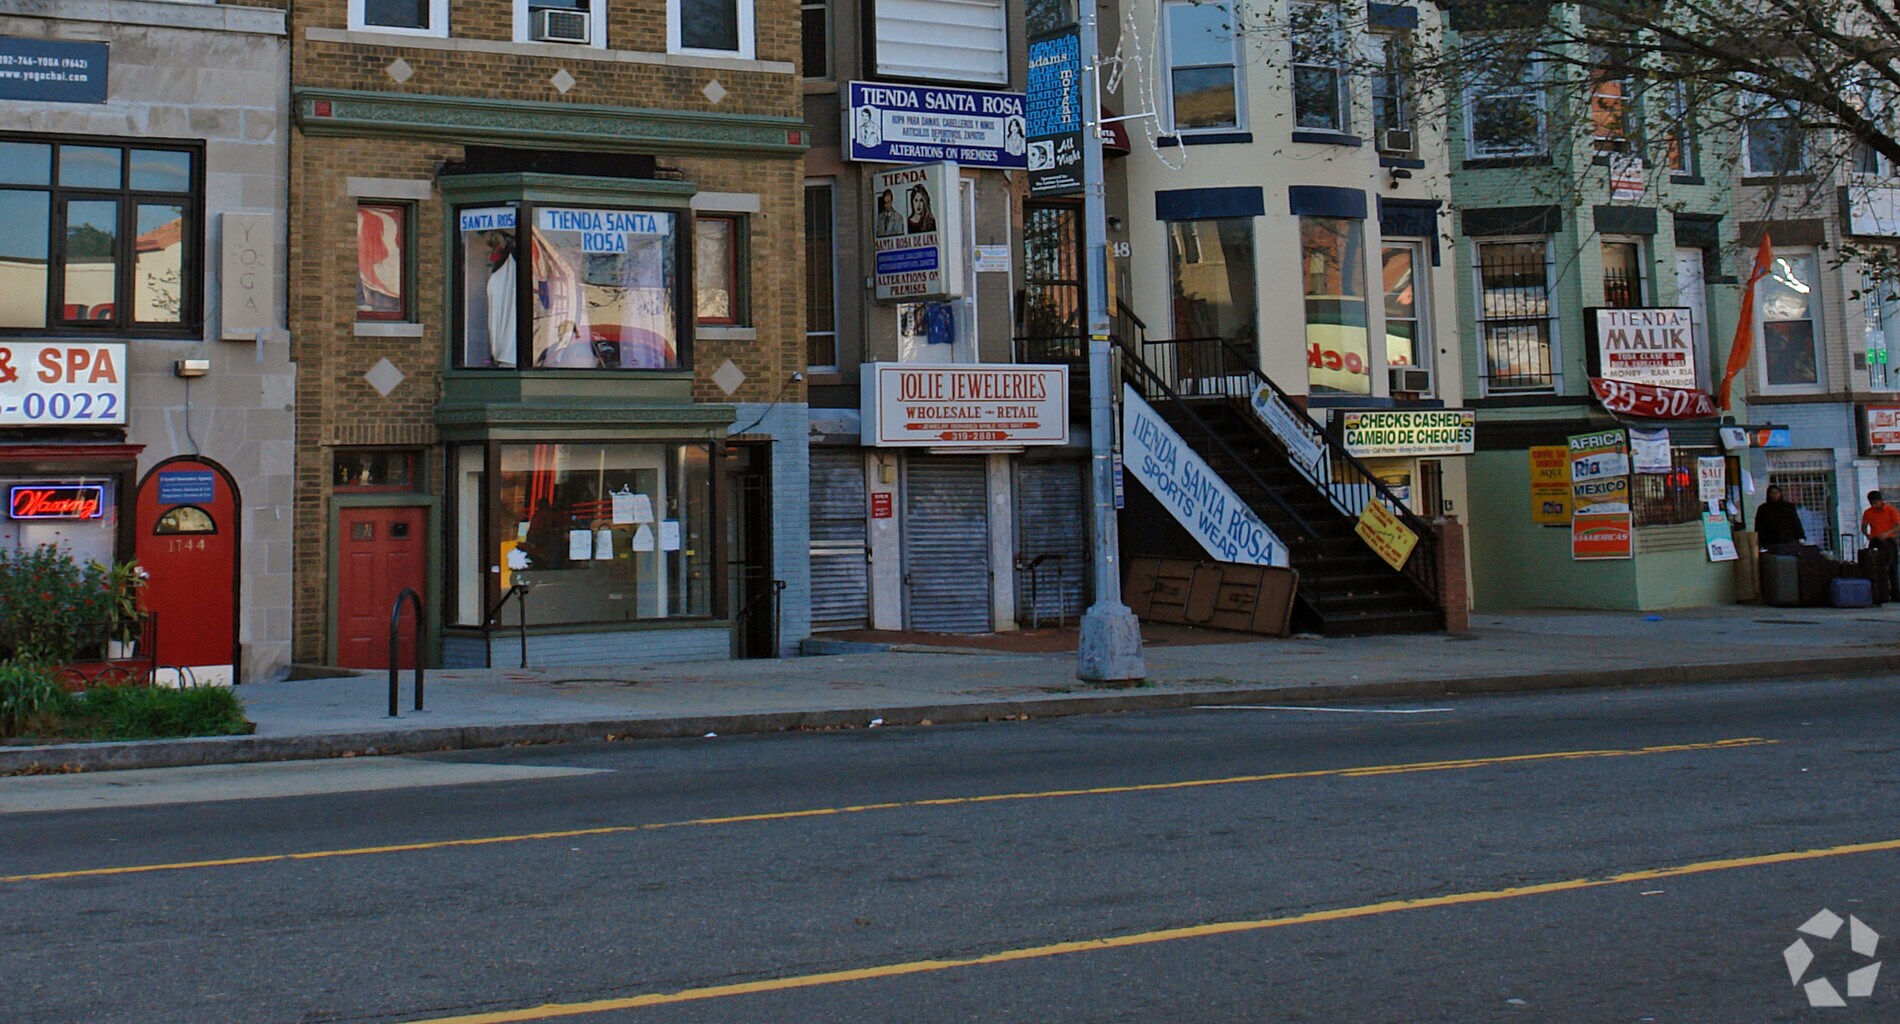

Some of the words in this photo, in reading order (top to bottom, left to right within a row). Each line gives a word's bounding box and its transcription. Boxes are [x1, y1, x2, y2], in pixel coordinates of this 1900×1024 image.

[1029, 53, 1067, 68] adams
[861, 87, 919, 108] TIENDA
[925, 92, 976, 112] SANTA
[982, 96, 1023, 115] ROSA
[1060, 70, 1072, 123] morgan
[889, 144, 943, 159] ALTERATIONS
[946, 147, 958, 159] ON
[960, 149, 998, 162] PREMISES
[882, 169, 927, 187] TIENDA
[462, 214, 494, 230] SANTA
[606, 212, 657, 233] SANTA
[583, 233, 626, 252] ROSA
[239, 222, 257, 313] YOGA
[878, 272, 927, 286] ALTERATIONS
[890, 283, 926, 296] PREMISES
[1608, 312, 1680, 326] TIENDA
[1605, 328, 1688, 350] MALIK
[37, 347, 118, 384] SPA
[1610, 369, 1641, 378] MONEY
[1679, 368, 1693, 376] RIA
[897, 373, 944, 402] JOLIE
[948, 373, 1046, 402] JEWELERIES
[0, 392, 117, 419] -0022
[906, 406, 981, 419] WHOLESALE
[997, 406, 1039, 418] RETAIL
[1360, 413, 1411, 428] CHECKS
[1413, 413, 1461, 428] CASHED
[952, 432, 996, 440] 319-2881
[1347, 430, 1396, 446] CAMBIO
[1398, 430, 1414, 444] DE
[1416, 428, 1472, 444] CHEQUES
[1570, 432, 1624, 450] AFRICA
[1575, 459, 1600, 477] Ria
[1132, 412, 1178, 475] TIENDA
[1181, 460, 1225, 525] SANTA
[1228, 508, 1273, 566] ROSA
[1573, 480, 1626, 495] MEXICO
[14, 490, 97, 518] Waxing
[1142, 455, 1195, 518] SPORTS
[1199, 511, 1239, 563] WEAR
[168, 539, 205, 553] 1744
